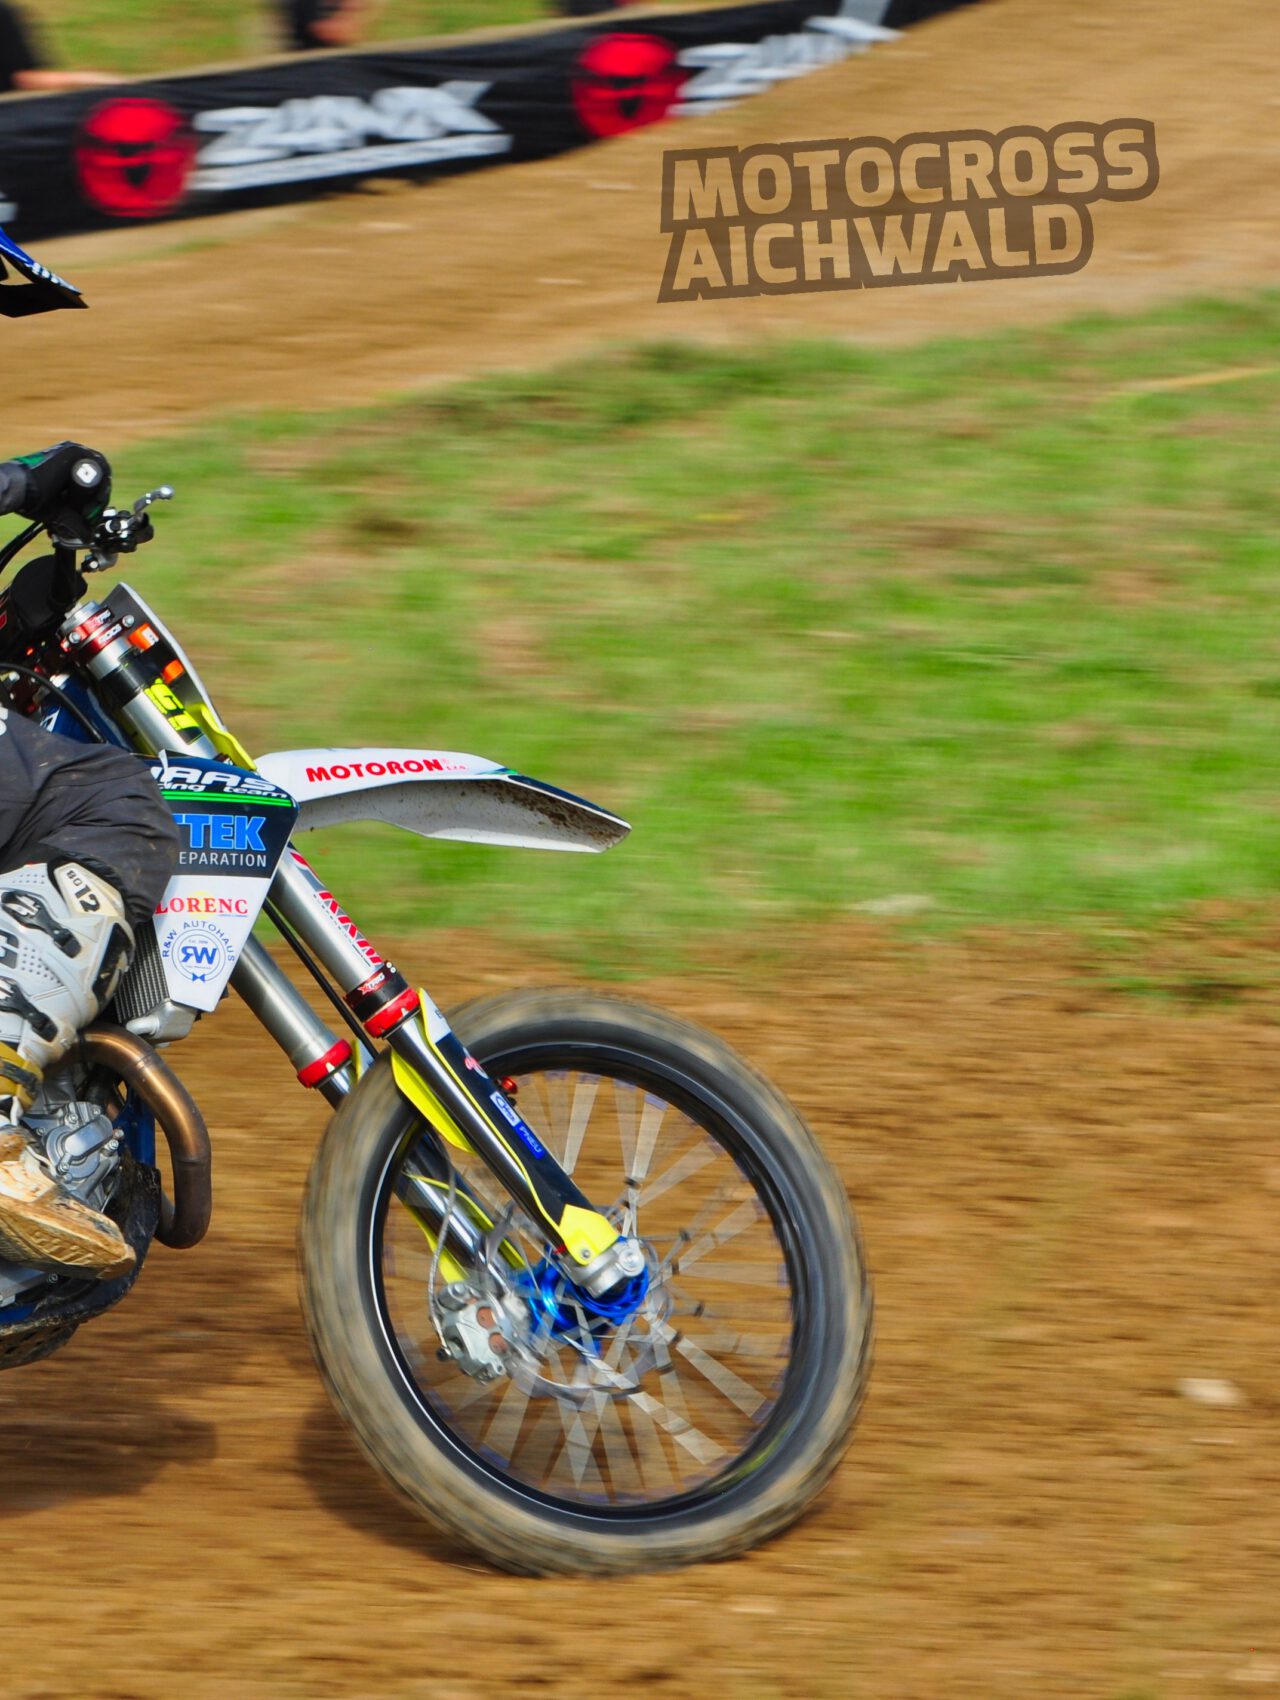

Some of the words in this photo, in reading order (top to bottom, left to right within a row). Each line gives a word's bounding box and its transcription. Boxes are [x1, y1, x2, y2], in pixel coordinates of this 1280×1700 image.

[151, 766, 277, 791] AAS
[306, 758, 444, 783] MOTORON
[223, 786, 288, 798] team
[178, 852, 267, 867] EPARATION
[155, 897, 248, 914] LORENC
[183, 920, 235, 962] AUTOHAUS
